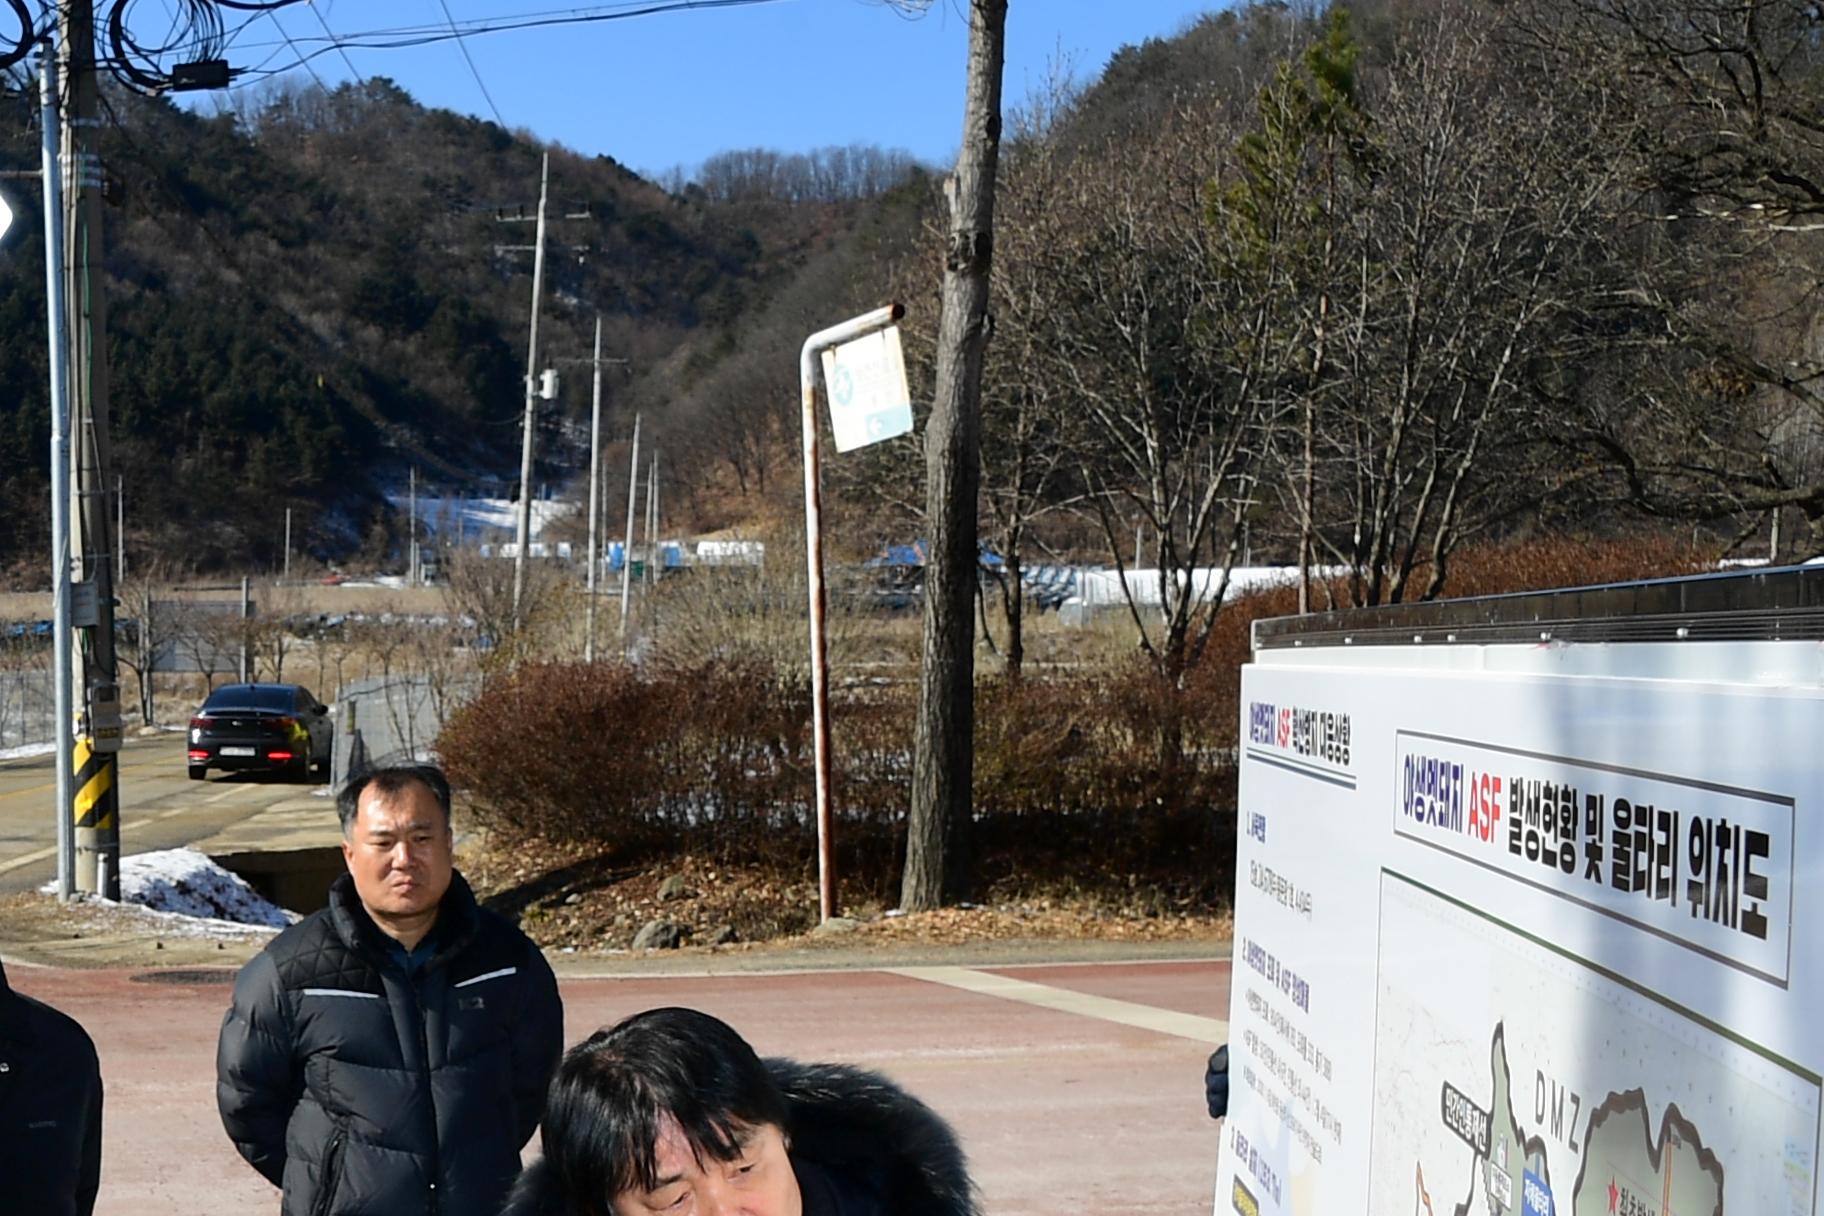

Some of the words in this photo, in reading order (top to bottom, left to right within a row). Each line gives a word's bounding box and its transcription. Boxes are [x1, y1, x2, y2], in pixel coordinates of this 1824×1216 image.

[1277, 708, 1290, 748] ASF
[1320, 712, 1351, 766] 대응상황
[1403, 754, 1464, 833] 야생멧돼지
[1468, 771, 1501, 843] ASF
[1509, 777, 1578, 874] 발생현황
[1585, 794, 1604, 885] 및
[1612, 798, 1679, 907] 울타리
[1687, 816, 1770, 940] 위치도
[1445, 1087, 1487, 1152] 민간인통제선
[1535, 1069, 1581, 1155] DMZ
